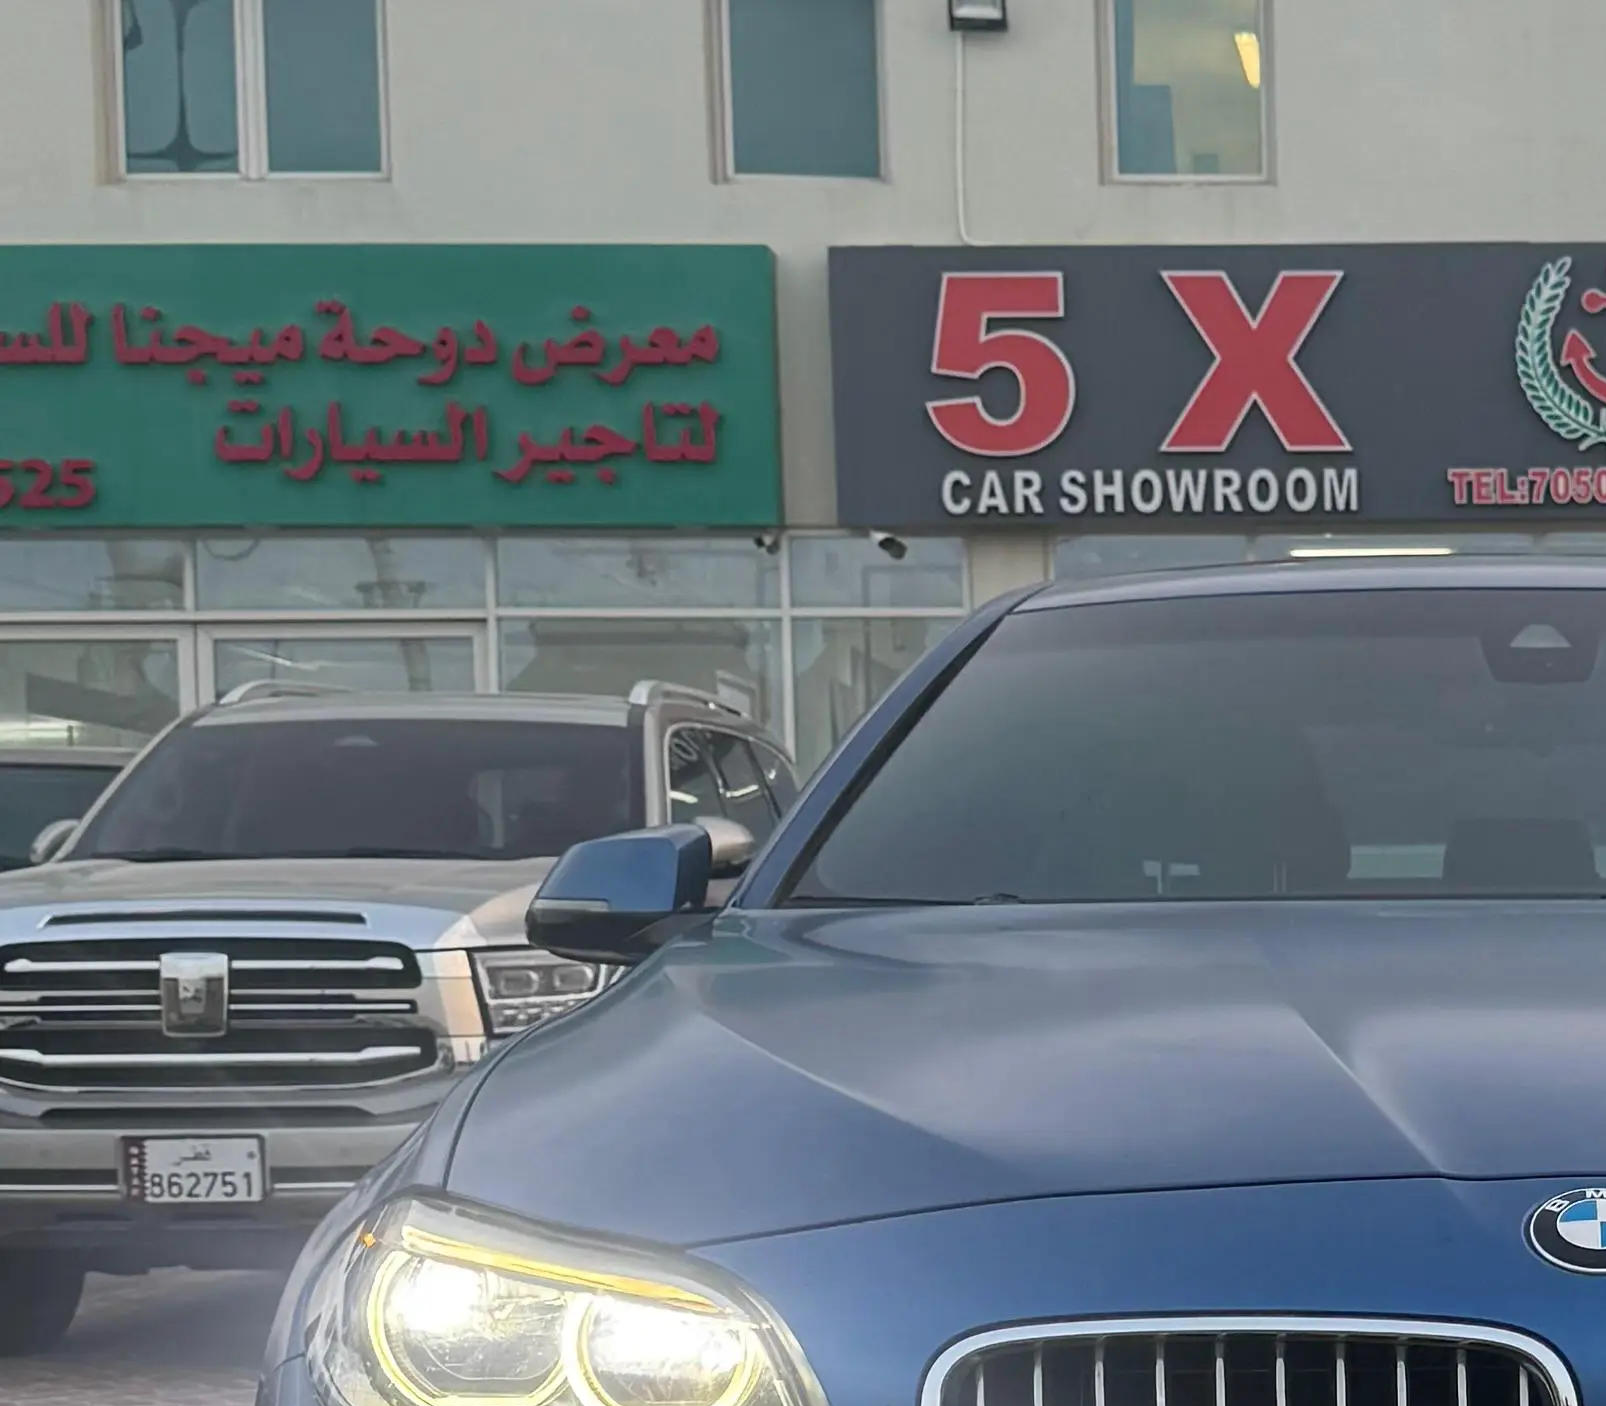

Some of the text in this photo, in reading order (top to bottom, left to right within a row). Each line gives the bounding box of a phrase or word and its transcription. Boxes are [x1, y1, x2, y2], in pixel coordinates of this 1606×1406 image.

[111, 303, 304, 383] ميجنا
[318, 300, 498, 384] دوحة
[513, 306, 721, 384] معرض
[926, 270, 1353, 456] 5 X
[215, 399, 721, 482] لتاجير السيارات
[942, 468, 1358, 514] CAR SHOWROOM
[150, 1172, 253, 1199] 862751
